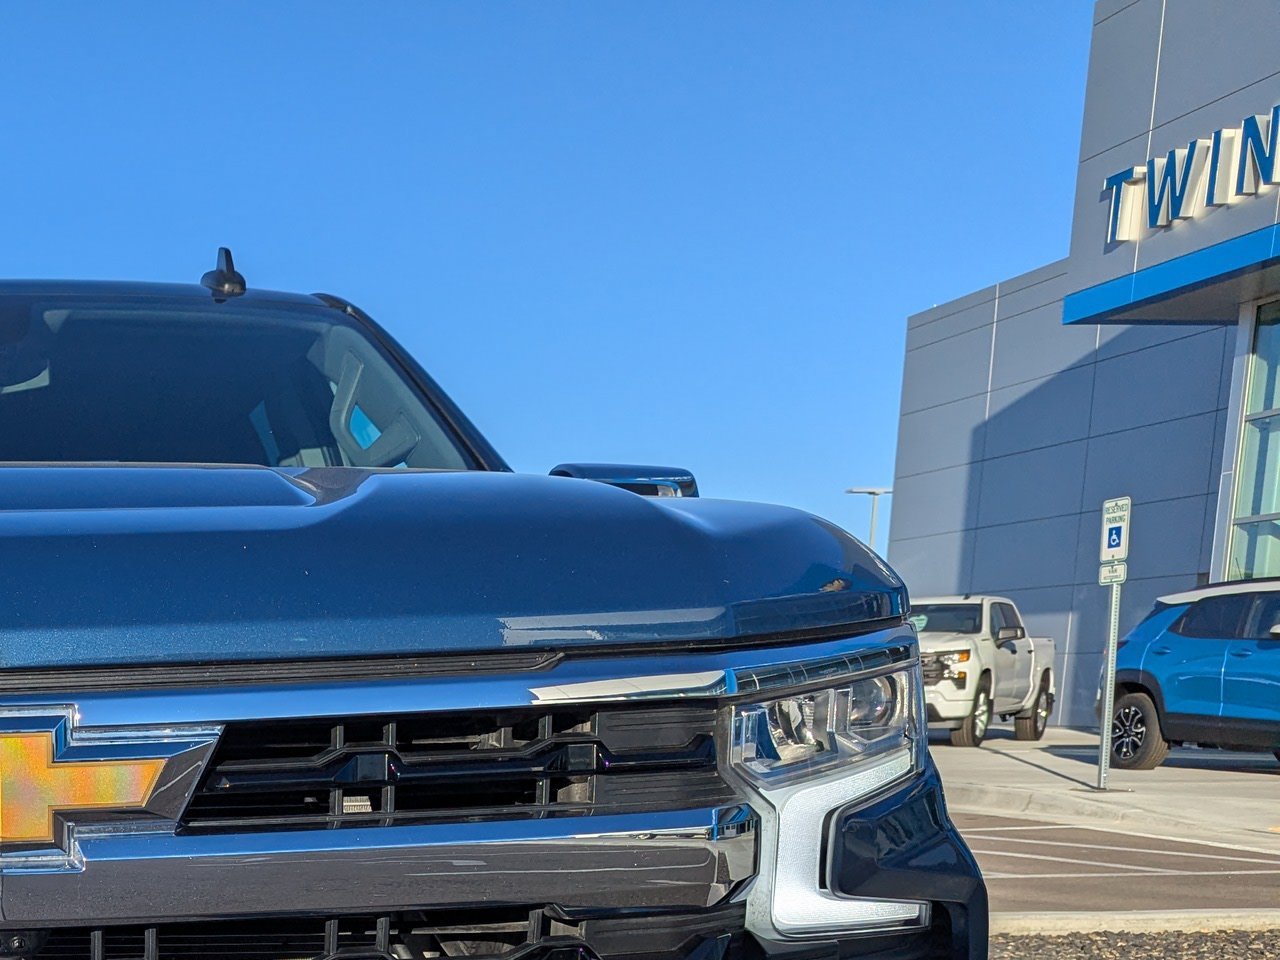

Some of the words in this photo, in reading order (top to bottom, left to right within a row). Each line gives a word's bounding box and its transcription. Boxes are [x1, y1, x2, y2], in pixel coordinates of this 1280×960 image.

[1104, 104, 1280, 244] TWIN
[1105, 503, 1128, 514] RESERVED
[1105, 514, 1126, 525] PARKING
